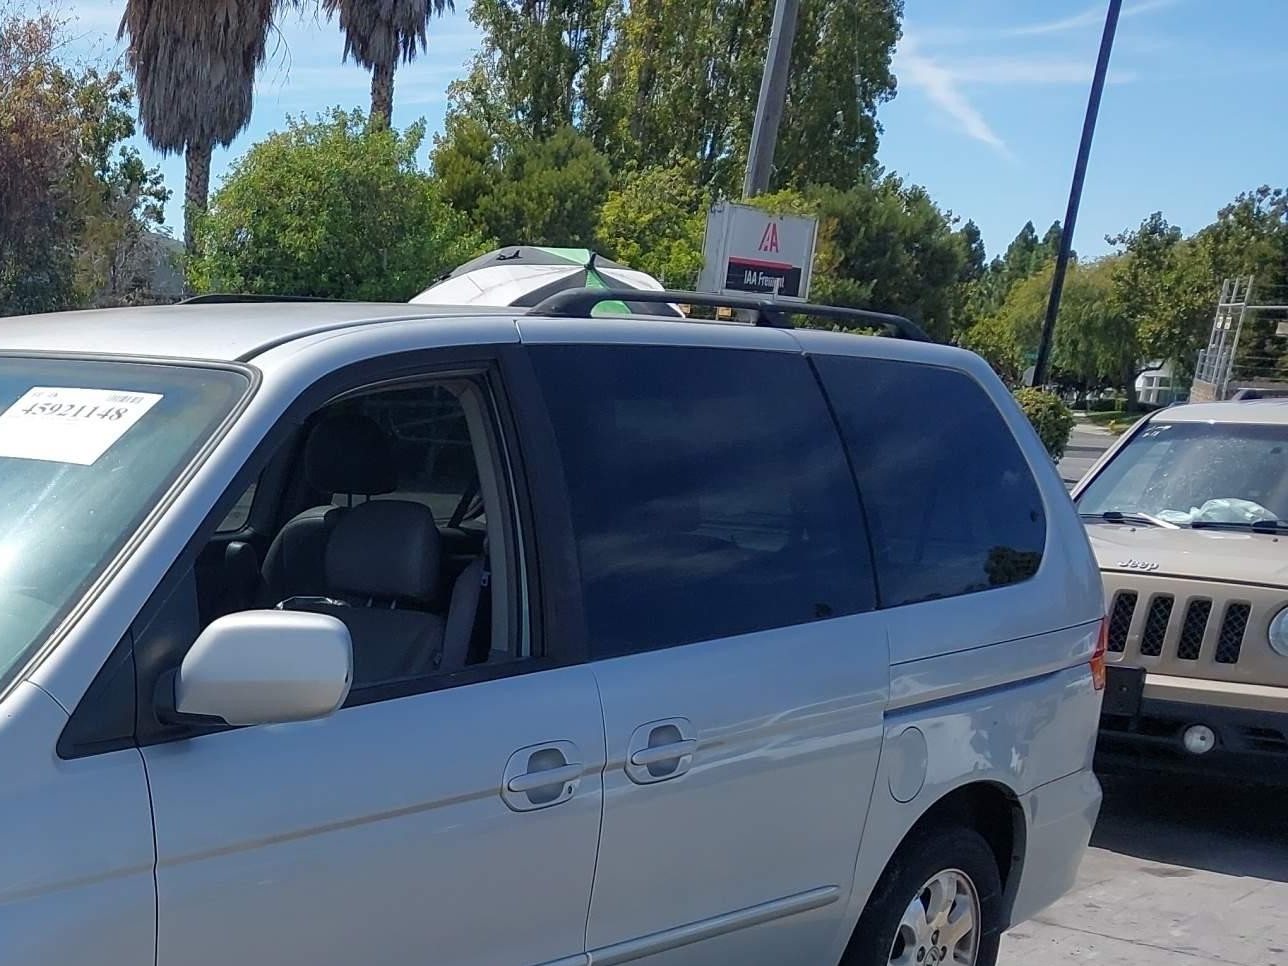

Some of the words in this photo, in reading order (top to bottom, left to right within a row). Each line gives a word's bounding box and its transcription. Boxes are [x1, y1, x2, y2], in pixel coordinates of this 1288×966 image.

[743, 270, 757, 286] IAA
[758, 271, 785, 288] Fremnt
[21, 402, 129, 421] 45921148
[1117, 559, 1160, 571] Jeep
